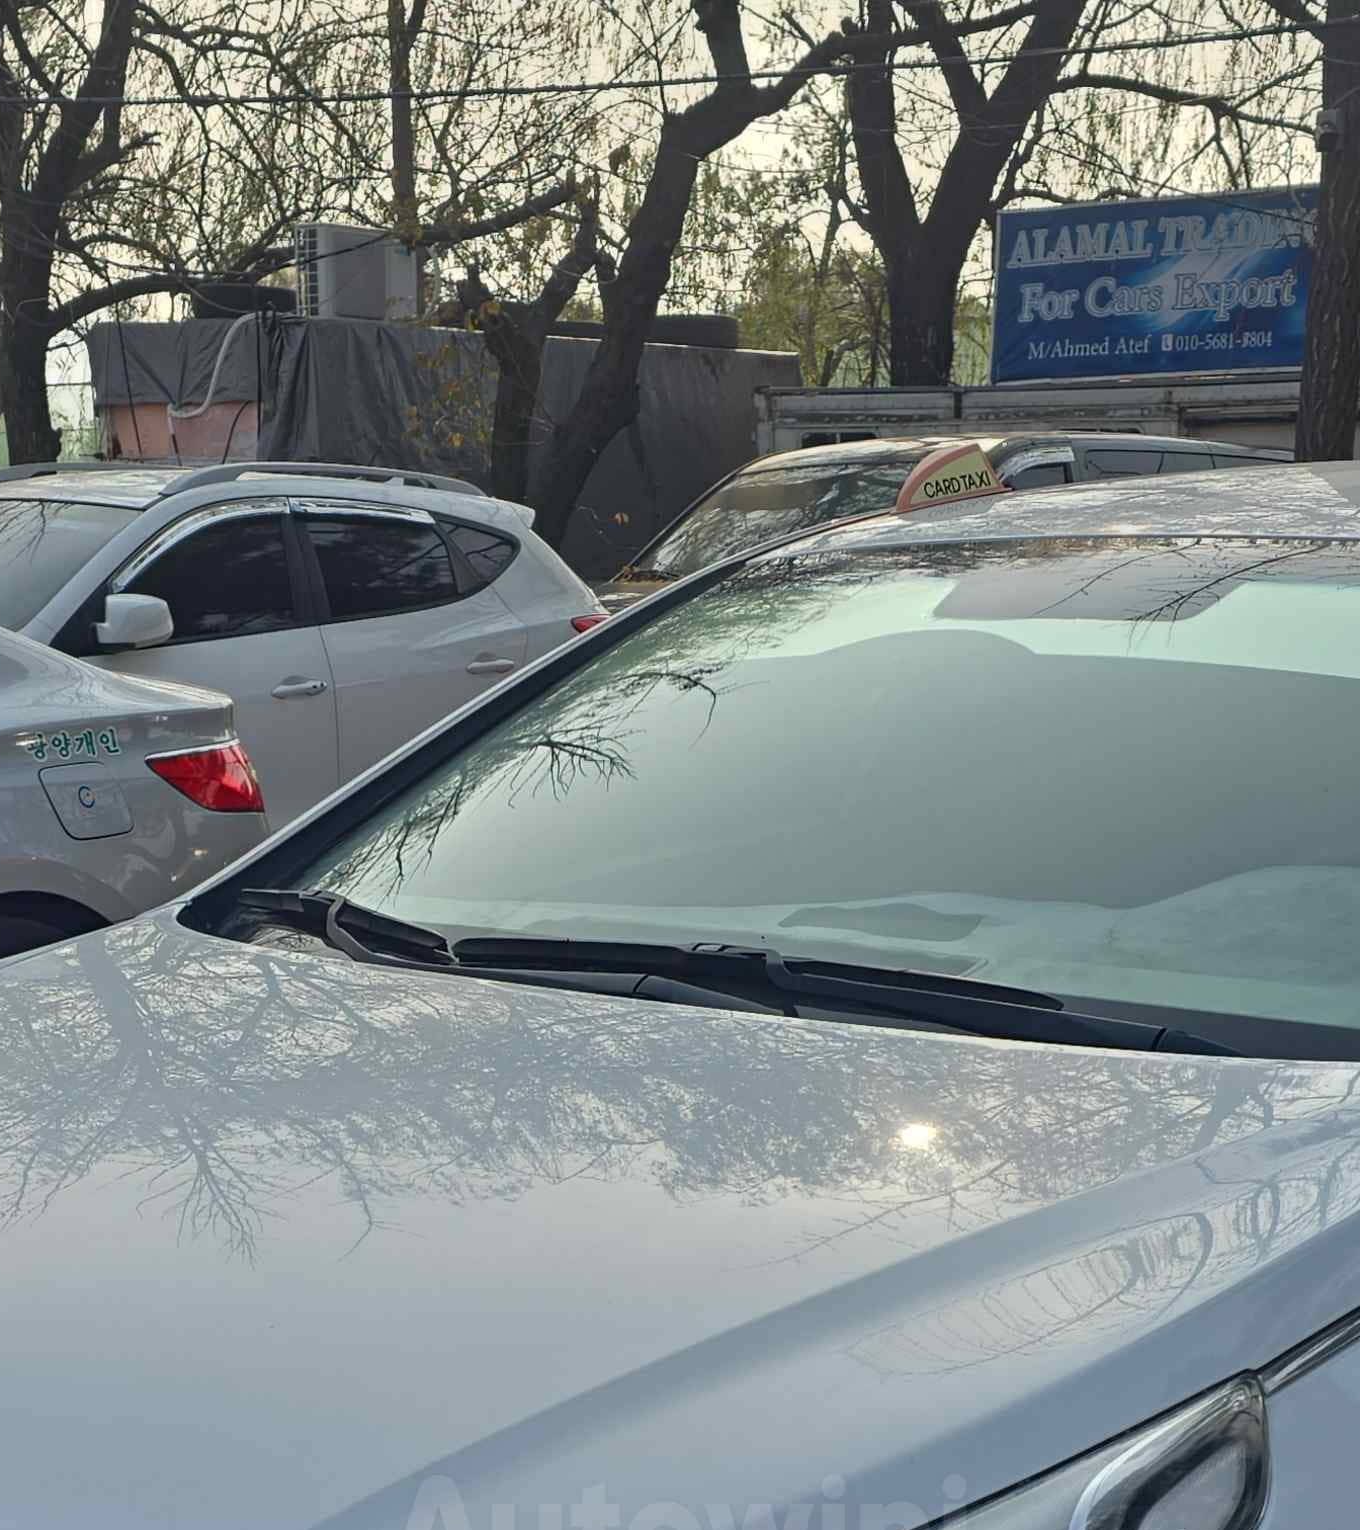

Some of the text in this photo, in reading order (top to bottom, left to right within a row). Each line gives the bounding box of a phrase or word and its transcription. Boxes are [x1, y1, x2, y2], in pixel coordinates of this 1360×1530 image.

[1007, 219, 1153, 269] ALAMAL
[1018, 268, 1298, 323] For Cars Export
[1027, 336, 1110, 361] M/Ahmed
[1114, 334, 1154, 355] Atef
